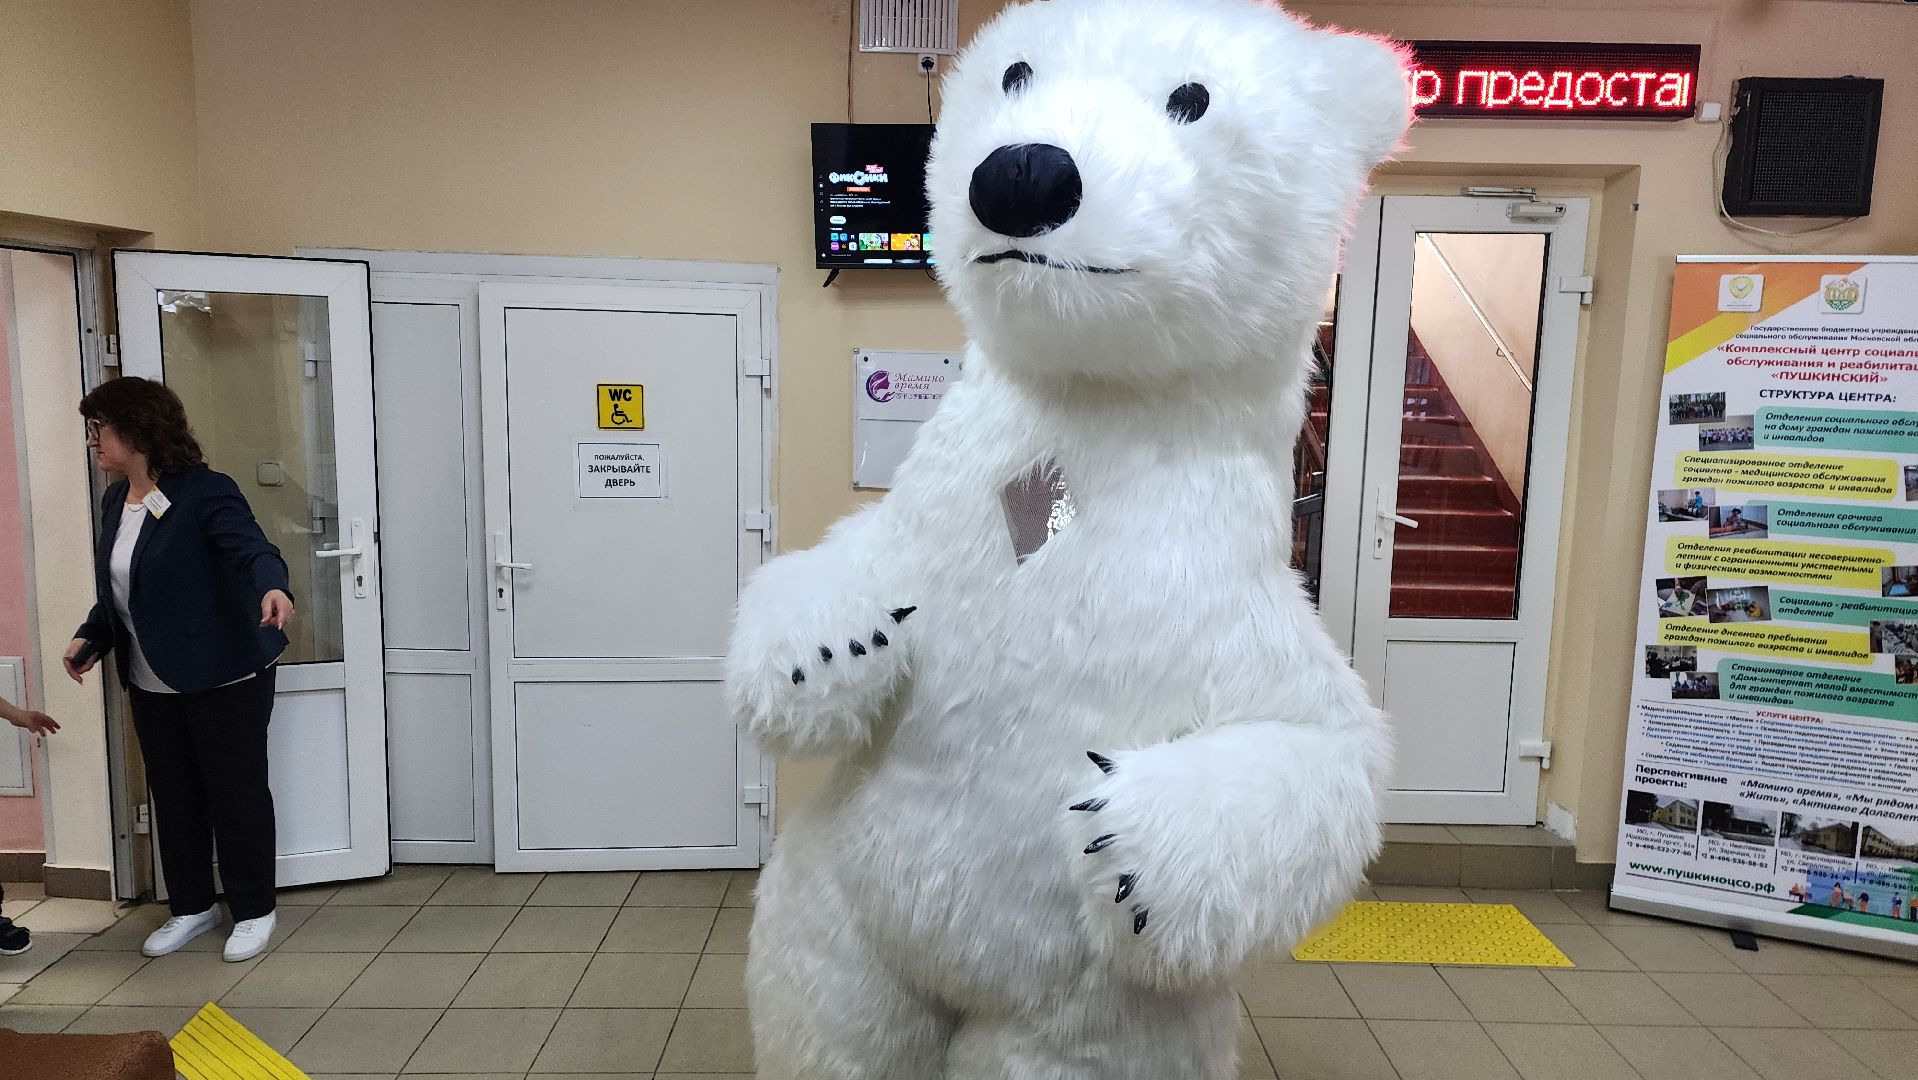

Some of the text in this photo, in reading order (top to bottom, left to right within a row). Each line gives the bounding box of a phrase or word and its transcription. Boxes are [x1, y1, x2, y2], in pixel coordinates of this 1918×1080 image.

[1403, 70, 1441, 107] р
[1788, 333, 1848, 341] обслуживания
[1850, 334, 1901, 342] Московской
[1717, 344, 1816, 354] «Комплексный
[1821, 347, 1861, 357] центр
[1727, 356, 1824, 368] обслуживания
[894, 372, 945, 383] Мамино
[1771, 371, 1888, 383] «ПУШКИНСКИЙ»
[894, 382, 930, 392] время
[608, 388, 633, 402] WC
[1759, 389, 1896, 403] СТРУКТУРА ЦЕНТРА:
[1765, 412, 1823, 422] Отделения
[1824, 415, 1889, 425] социального
[1778, 423, 1804, 433] дому
[1806, 425, 1851, 434] граждан
[1853, 427, 1905, 436] пожилого
[1771, 434, 1824, 443] инвалидов
[594, 453, 645, 462] ПОЖАЛУЙСТА,
[1684, 455, 1844, 471] Специализированное отделение
[588, 463, 651, 474] ЗАКРЫВАЙТЕ
[1683, 466, 1733, 475] социально
[1740, 468, 1810, 479] медицинского
[1812, 472, 1886, 483] обслуживания
[605, 479, 636, 488] ДВЕРЬ
[1682, 476, 1724, 484] граждан
[1725, 478, 1775, 486] пожилого
[1776, 481, 1825, 490] возраста
[1837, 484, 1893, 494] инвалидов
[1777, 508, 1883, 522] Отделения срочного
[1776, 520, 1917, 535] социального обслуживания
[1677, 542, 1886, 564] Отделения реабилитации несовершенно-
[1683, 562, 1746, 574] физическими
[1748, 568, 1833, 580] возможностями
[1720, 556, 1799, 568] ограниченными
[1800, 562, 1874, 574] умственными
[1779, 596, 1833, 608] Социально
[1778, 607, 1834, 618] отделение
[1665, 623, 1828, 646] Отделение дневного пребывания
[1664, 633, 1706, 643] граждан
[1707, 638, 1756, 648] пожилого
[1757, 643, 1805, 653] возраста
[1815, 648, 1869, 659] инвалидов
[1731, 663, 1862, 683] Стационарное отделение
[1730, 673, 1813, 688] «Дом-интернат
[1814, 682, 1848, 692] малой
[1729, 682, 1895, 707] для граждан пожилого возраста
[1737, 693, 1794, 705] инвалидов»
[1756, 710, 1788, 720] УСЛУГИ
[1634, 775, 1687, 788] проекты:
[1635, 764, 1728, 785] Перспективные
[1740, 780, 1794, 794] «Мамино
[1796, 787, 1841, 800] время»,
[1846, 793, 1873, 804] «Мы
[1739, 790, 1788, 805] «Жить»,
[1792, 798, 1858, 813] «Активное
[1629, 861, 1776, 894] www.пушкиноцсо.рф
